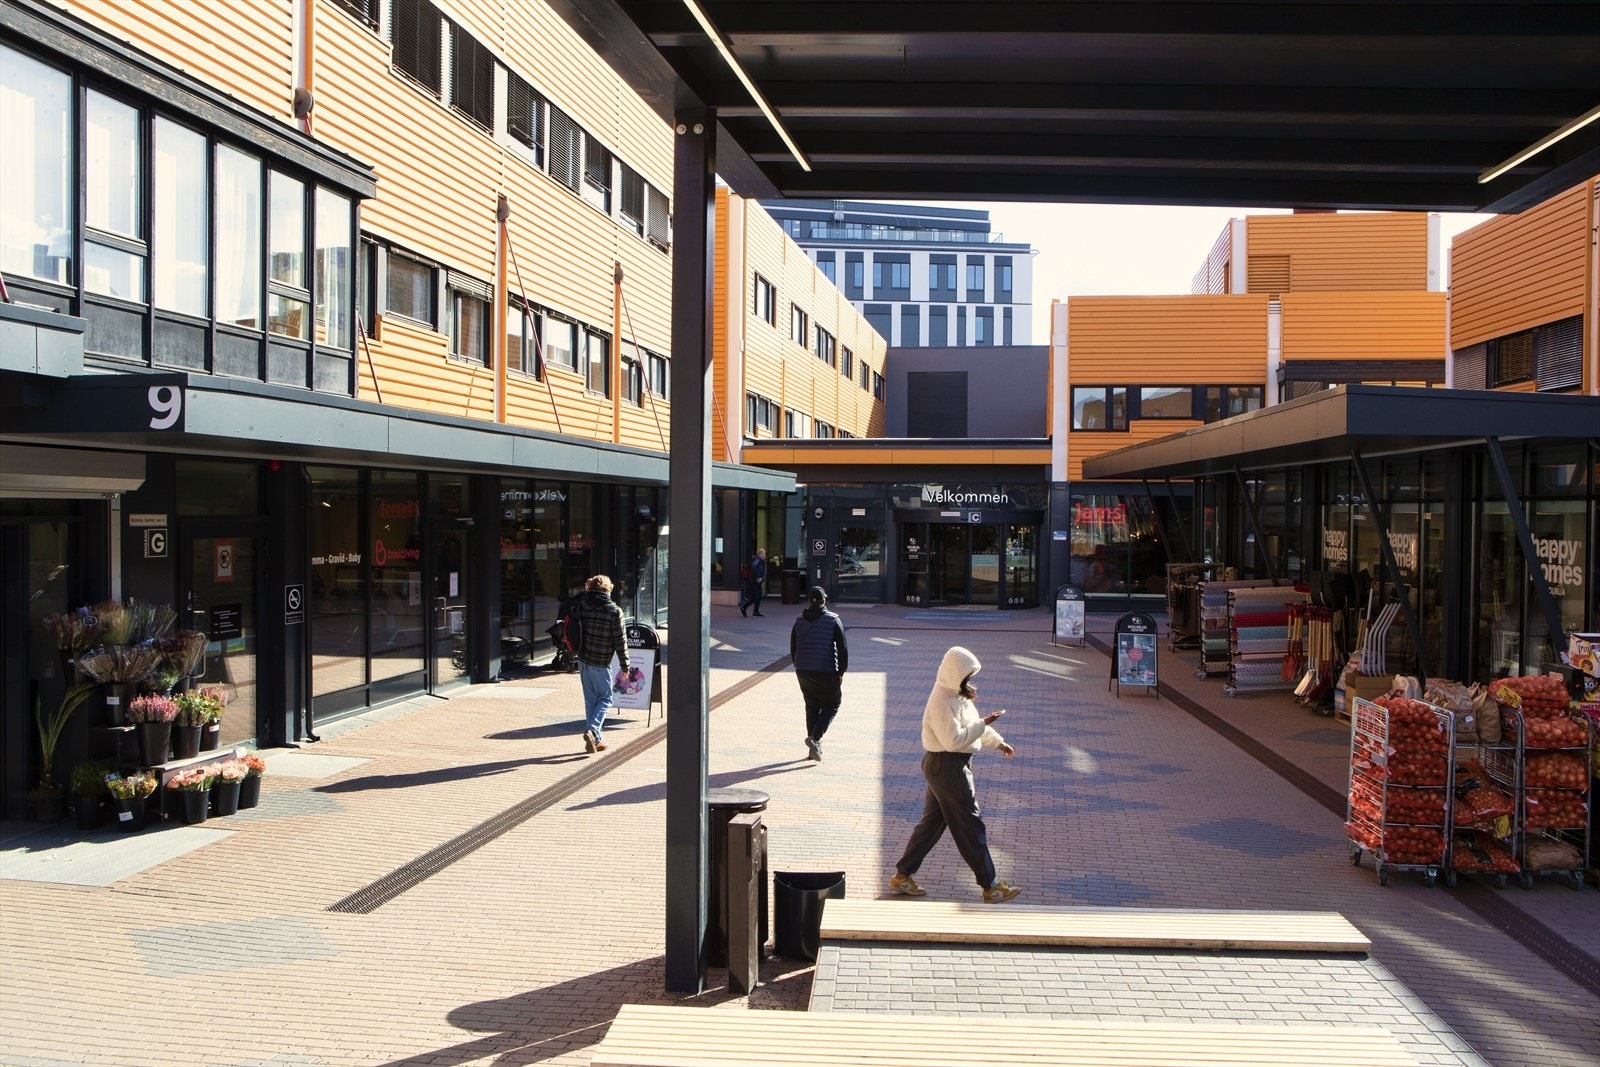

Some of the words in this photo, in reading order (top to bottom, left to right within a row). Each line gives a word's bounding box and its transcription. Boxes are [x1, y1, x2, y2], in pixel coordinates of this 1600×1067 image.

[148, 386, 182, 430] 9
[925, 488, 1008, 504] Velkommen
[972, 513, 980, 522] C
[151, 533, 165, 553] G
[1323, 527, 1346, 547] happy
[328, 553, 345, 564] Gravid
[348, 552, 361, 564] Baby
[1323, 543, 1348, 561] homes
[1540, 563, 1583, 586] omes
